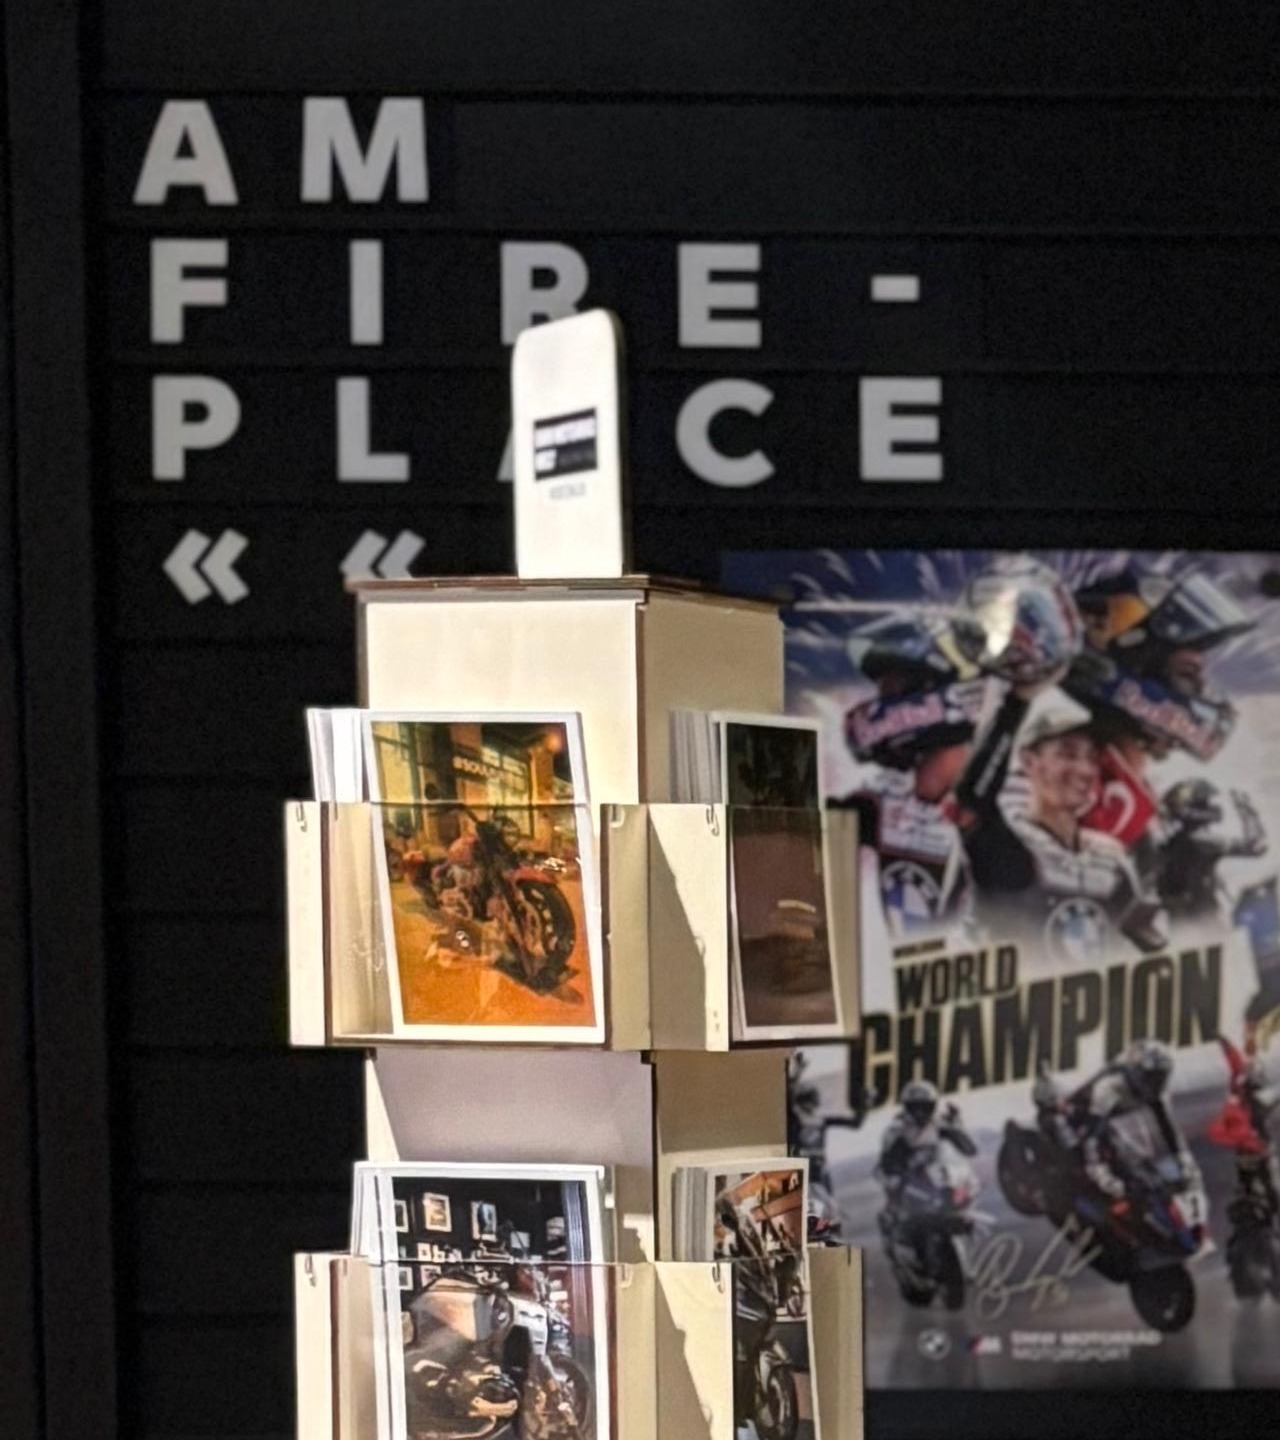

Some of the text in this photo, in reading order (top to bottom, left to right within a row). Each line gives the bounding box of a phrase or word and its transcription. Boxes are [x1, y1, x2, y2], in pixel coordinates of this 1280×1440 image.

[151, 375, 944, 489] PLCE
[847, 945, 1223, 1113] CHAMPION
[893, 944, 1019, 1012] WORLD
